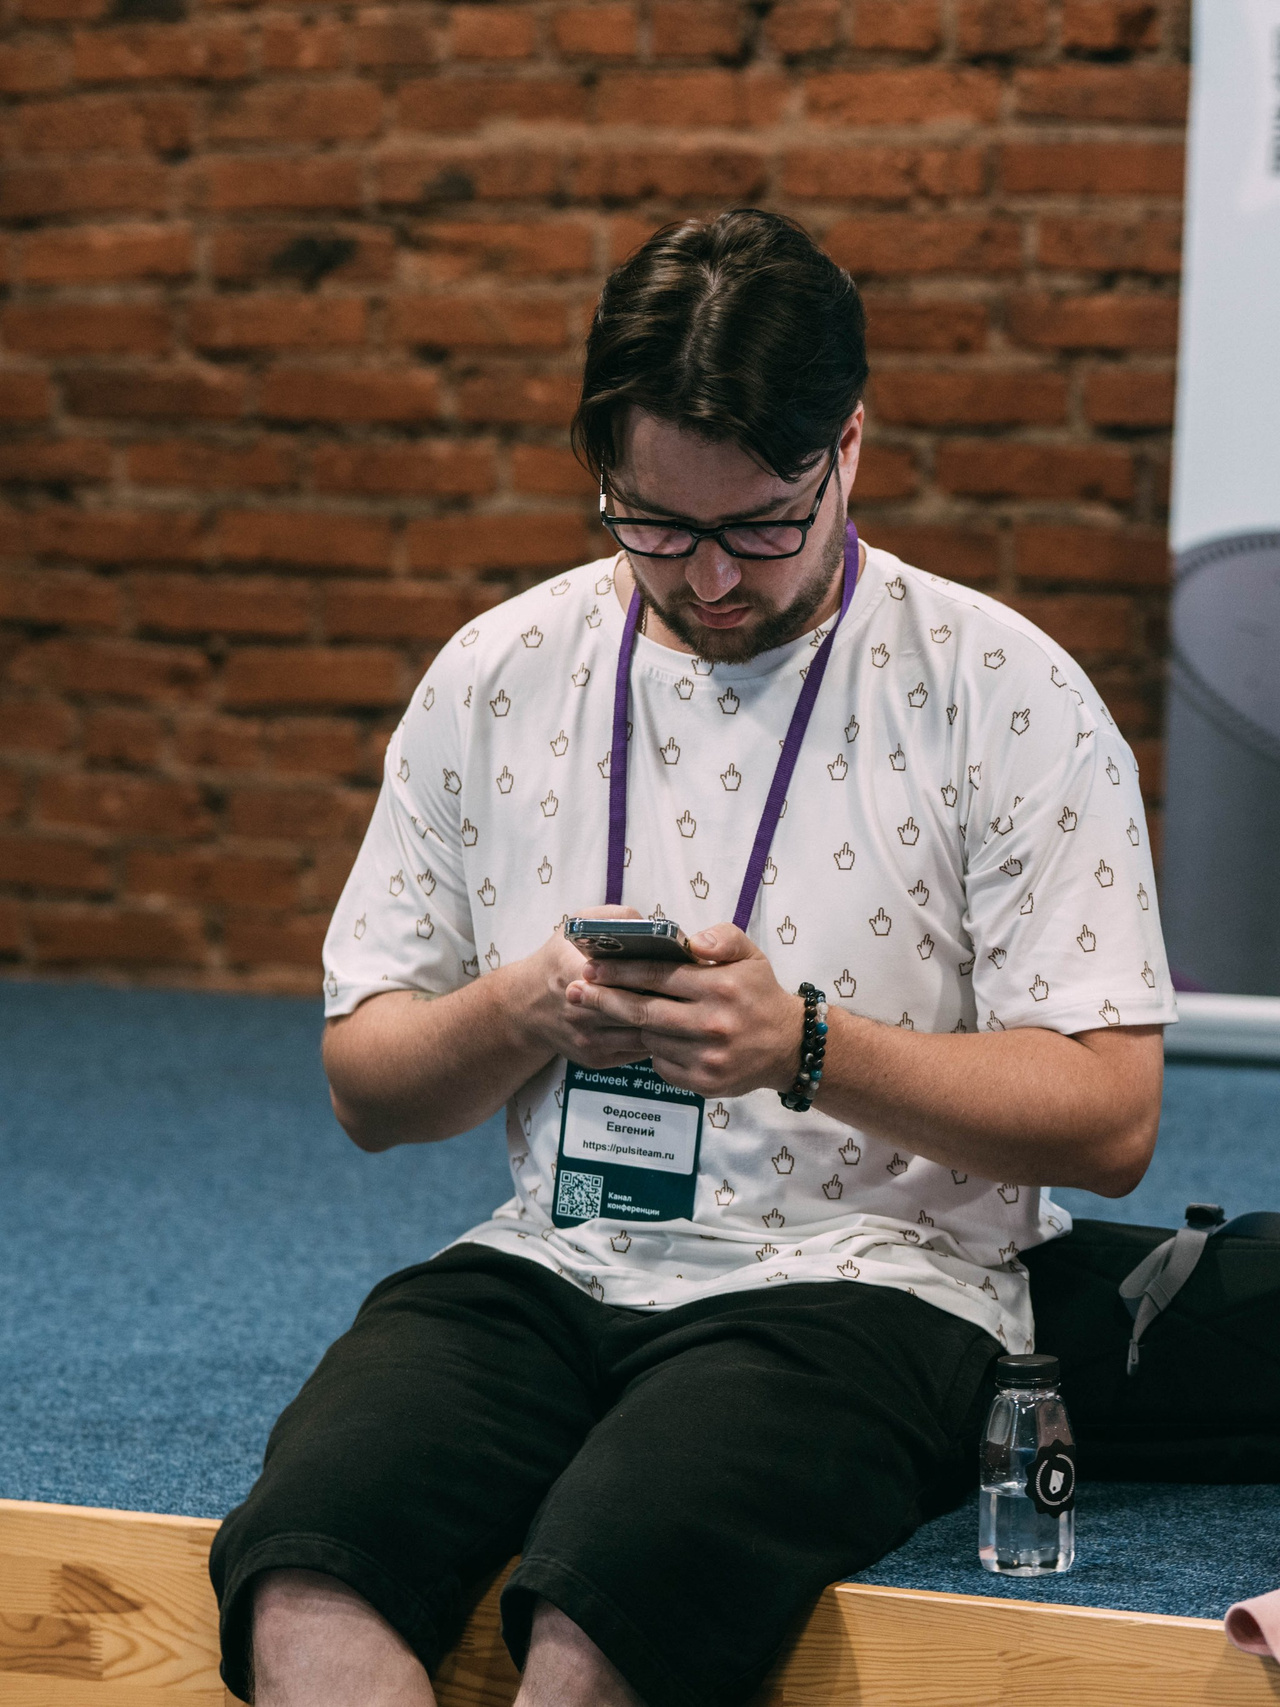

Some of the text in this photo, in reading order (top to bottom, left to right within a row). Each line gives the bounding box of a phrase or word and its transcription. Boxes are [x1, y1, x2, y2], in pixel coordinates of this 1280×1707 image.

[574, 1070, 629, 1087] #udweek
[602, 1105, 661, 1122] Федосеев
[606, 1121, 655, 1137] Евгений
[582, 1140, 675, 1160] https://pulsiteam.ru
[607, 1191, 632, 1202] Канал
[607, 1202, 660, 1216] конференции
